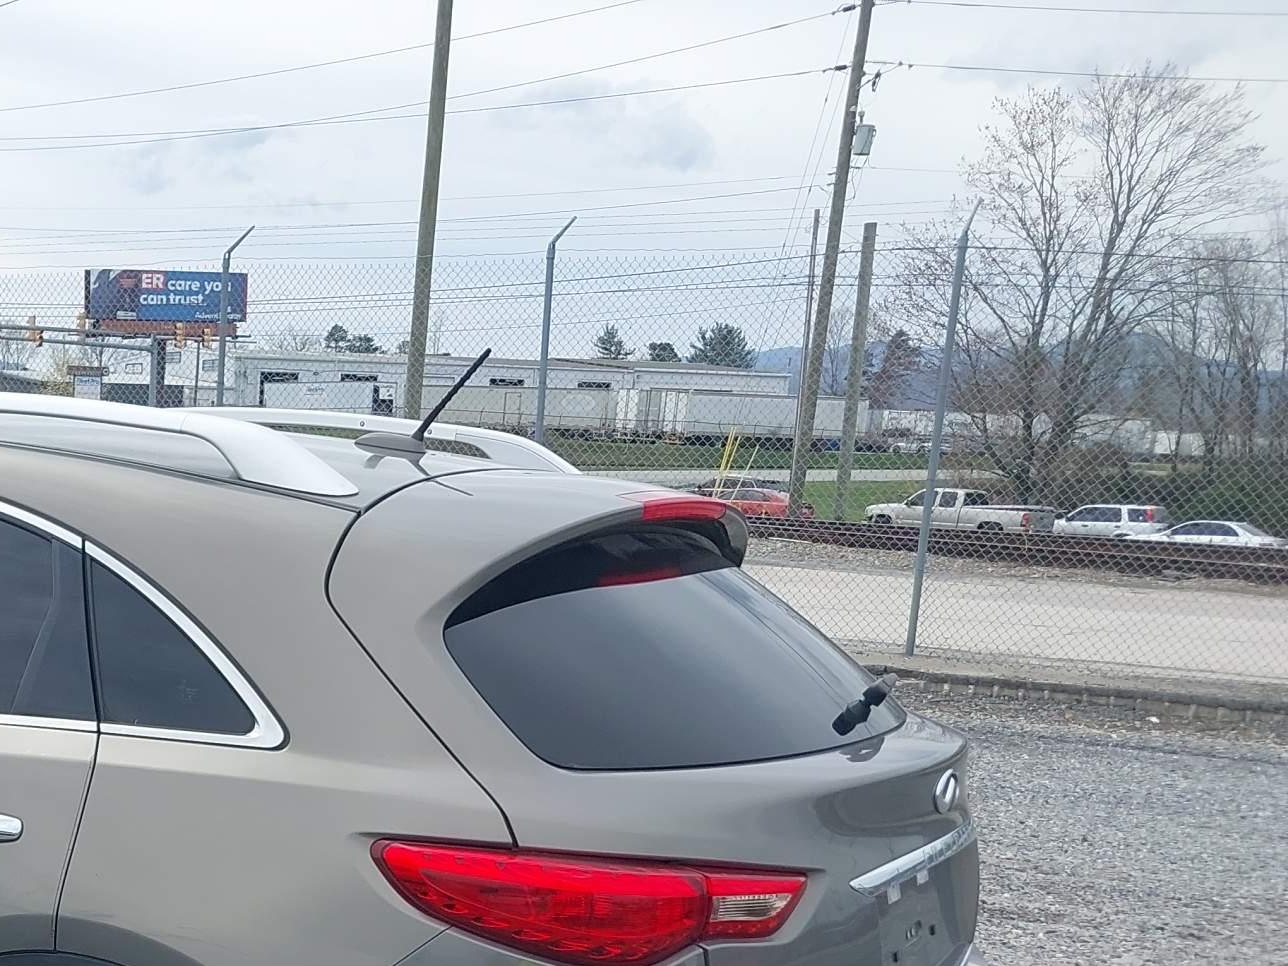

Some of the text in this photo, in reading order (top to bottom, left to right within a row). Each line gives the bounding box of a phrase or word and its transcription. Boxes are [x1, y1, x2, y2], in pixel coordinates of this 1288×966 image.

[141, 273, 165, 289] ER
[167, 280, 201, 291] care
[139, 294, 167, 305] can
